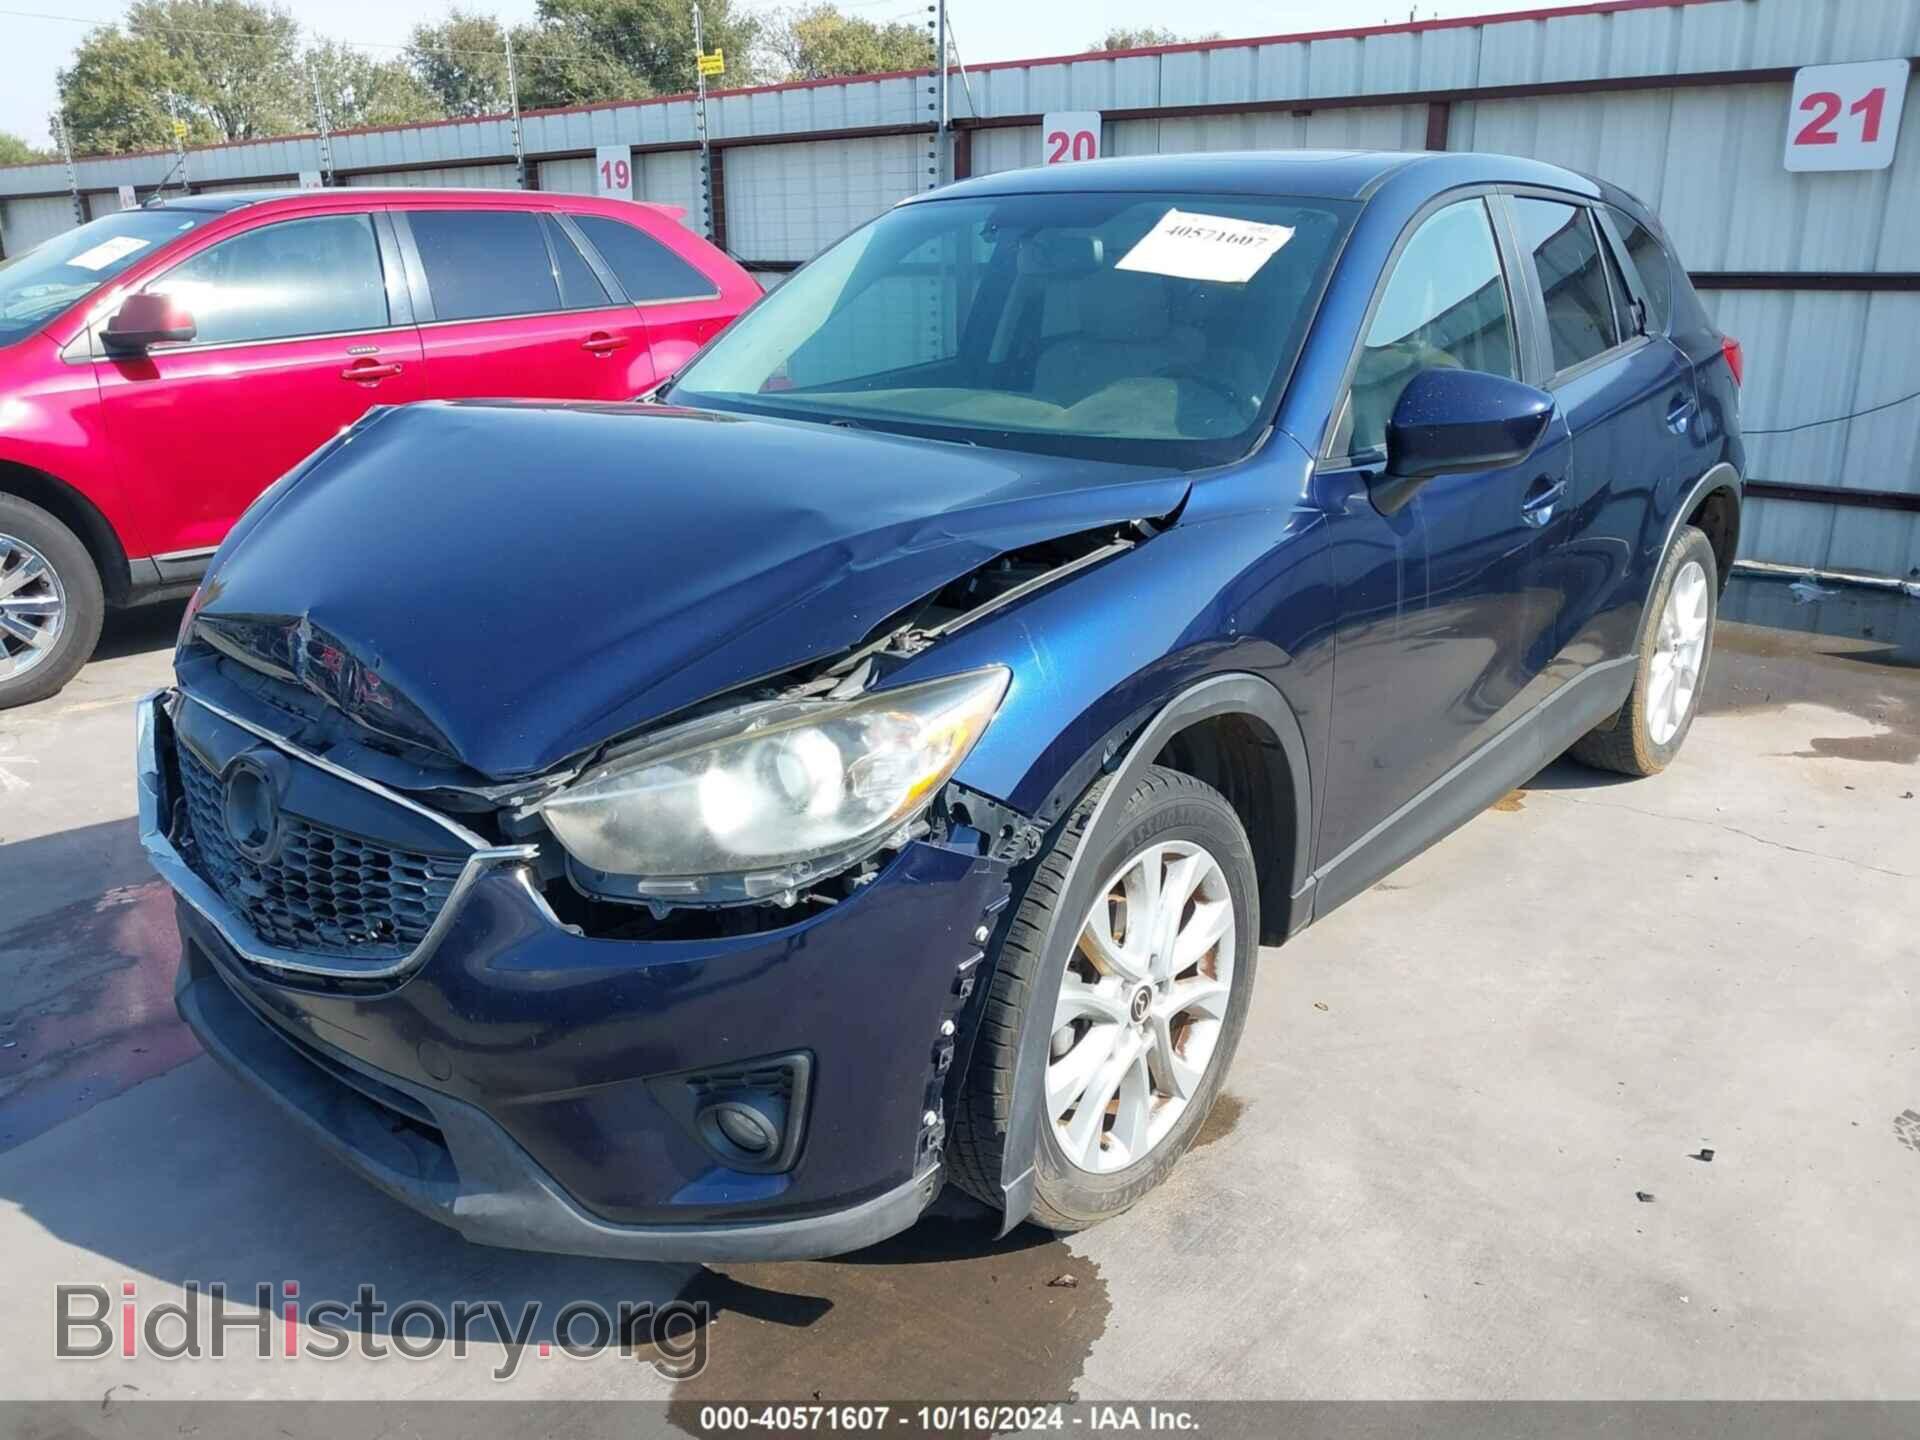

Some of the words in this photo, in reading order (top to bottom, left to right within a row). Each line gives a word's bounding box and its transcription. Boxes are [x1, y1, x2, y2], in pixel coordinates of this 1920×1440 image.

[1794, 87, 1886, 146] 21
[1047, 131, 1096, 164] 20
[601, 160, 629, 189] 19
[1165, 224, 1269, 248] 40571607
